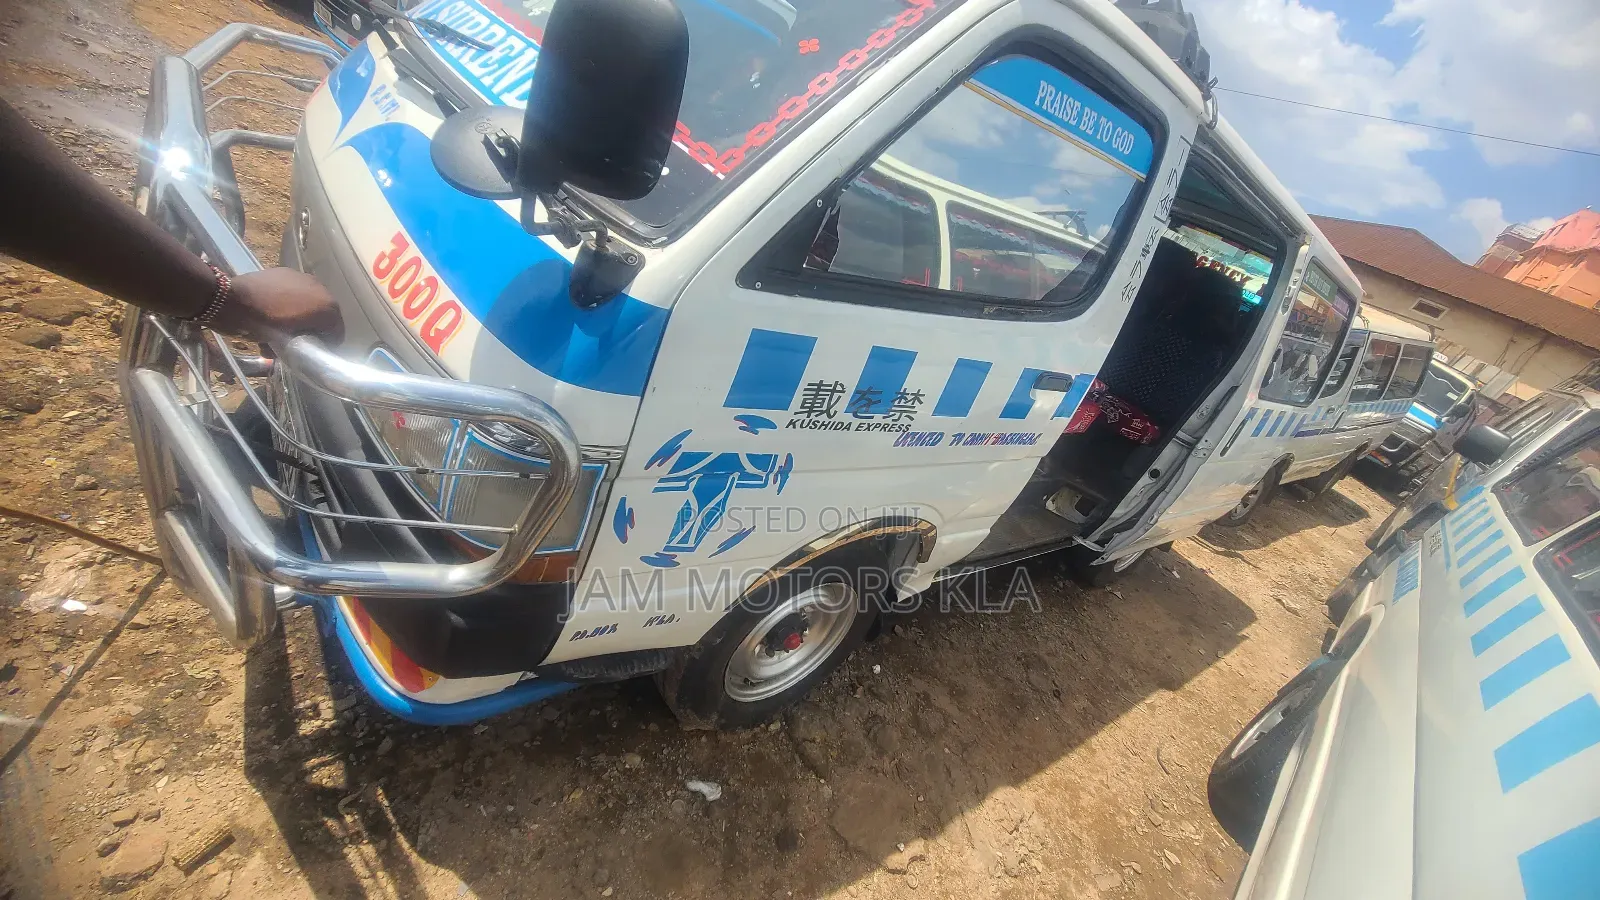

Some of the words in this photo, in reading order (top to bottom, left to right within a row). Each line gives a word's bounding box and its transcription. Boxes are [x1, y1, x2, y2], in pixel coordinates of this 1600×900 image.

[1035, 80, 1081, 125] PRAISE
[1079, 107, 1097, 135] BE
[1097, 116, 1112, 143] TO
[1112, 127, 1134, 155] GOD
[373, 231, 463, 356] 300Q
[785, 418, 852, 432] KUSHIDA
[855, 422, 912, 433] EXPRESS
